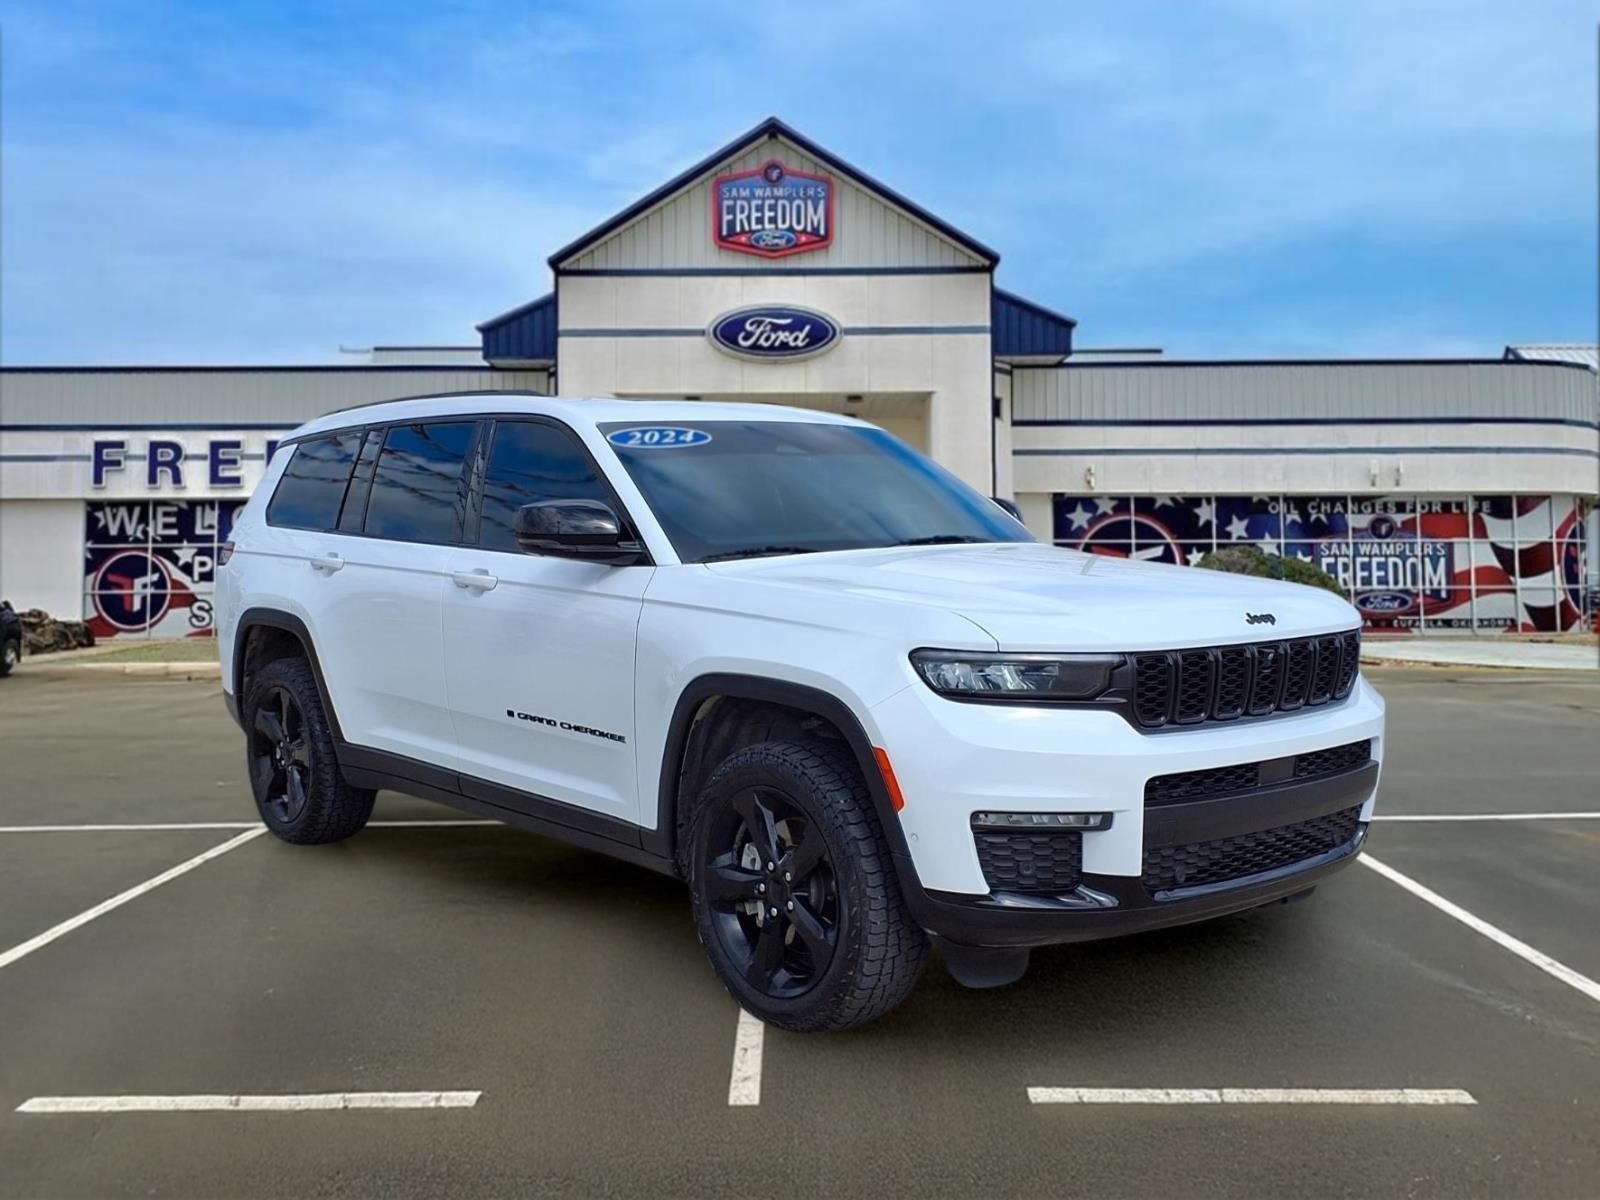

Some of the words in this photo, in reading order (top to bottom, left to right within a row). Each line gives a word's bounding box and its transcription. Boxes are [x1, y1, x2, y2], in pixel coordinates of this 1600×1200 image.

[722, 187, 750, 198] SAM
[722, 199, 825, 236] FREEDOM
[758, 233, 789, 247] Ford
[737, 316, 811, 348] Ford
[627, 430, 696, 446] 2024
[93, 440, 278, 486] FRE
[1267, 502, 1299, 514] OIL
[1307, 501, 1397, 514] CHANGES
[1406, 500, 1442, 513] FOR
[1451, 501, 1491, 513] LIFE
[1365, 595, 1400, 609] Ford
[1245, 612, 1276, 626] Jeep
[517, 712, 557, 727] GRAND
[560, 721, 626, 743] CHEROKEE
